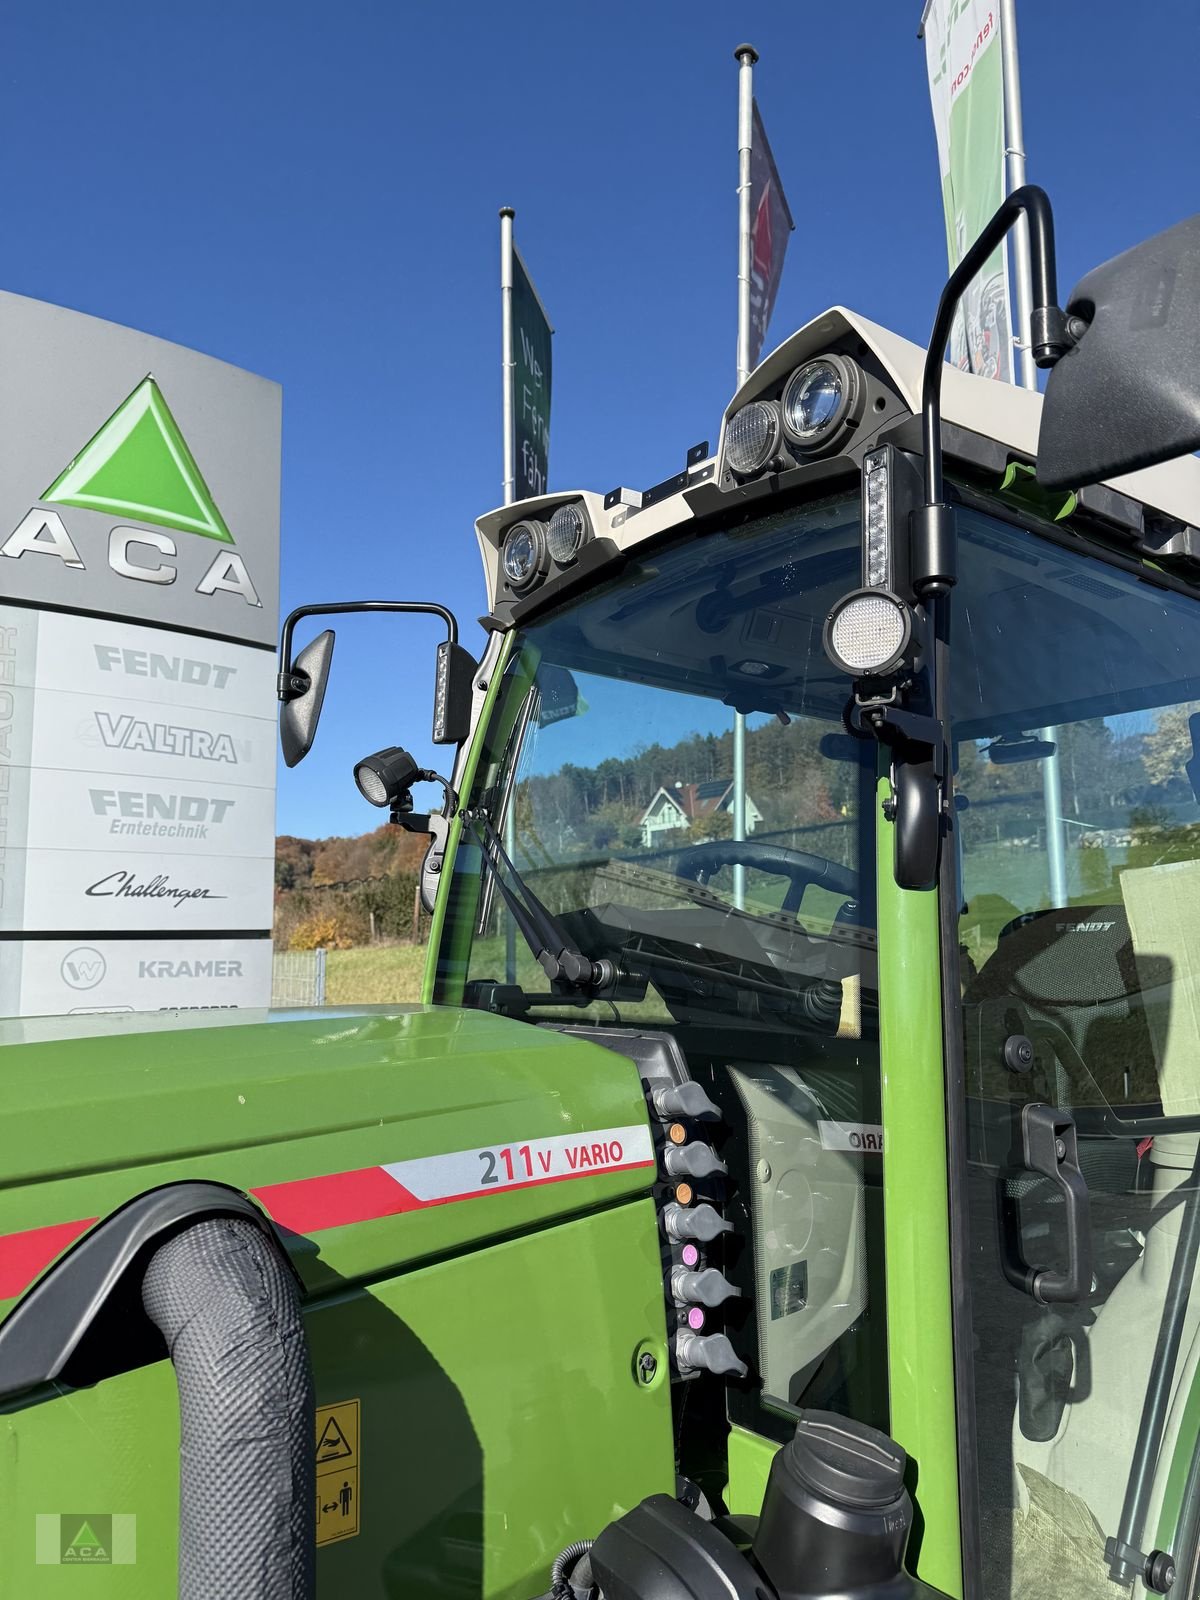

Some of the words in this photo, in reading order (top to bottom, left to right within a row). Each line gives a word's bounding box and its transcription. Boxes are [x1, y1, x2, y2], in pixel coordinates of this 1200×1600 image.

[0, 507, 263, 608] ACA
[94, 644, 238, 690] FENDT
[94, 711, 238, 764] VALTRA
[88, 788, 236, 824] FENDT
[109, 818, 209, 839] Erntetechnik
[85, 871, 228, 908] Challenger
[1055, 921, 1117, 933] FENDT
[138, 960, 244, 978] KRAMER
[565, 1140, 623, 1170] VARIO
